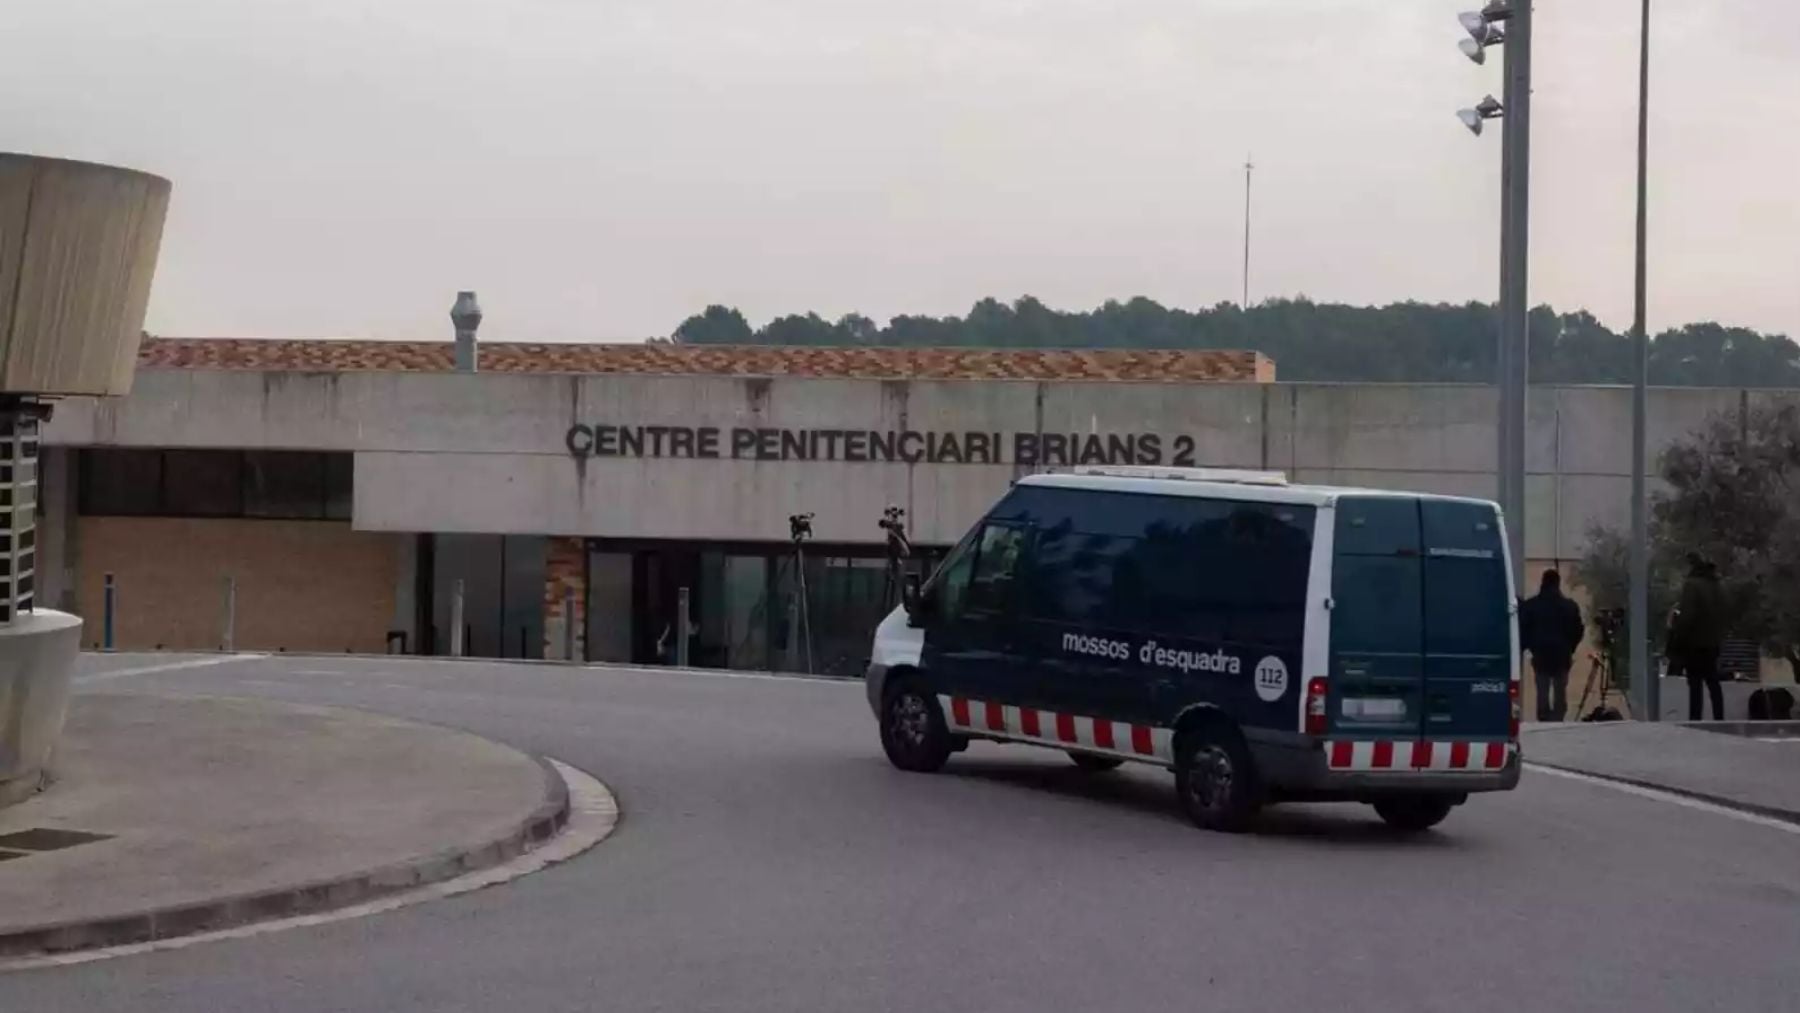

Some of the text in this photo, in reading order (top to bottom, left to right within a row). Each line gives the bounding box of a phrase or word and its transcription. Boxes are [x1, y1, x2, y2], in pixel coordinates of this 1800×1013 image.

[566, 424, 1196, 467] CENTRE PENITENCIARI BRIANS 2
[1062, 633, 1241, 674] mossos d'esquadra
[1260, 667, 1283, 685] 112
